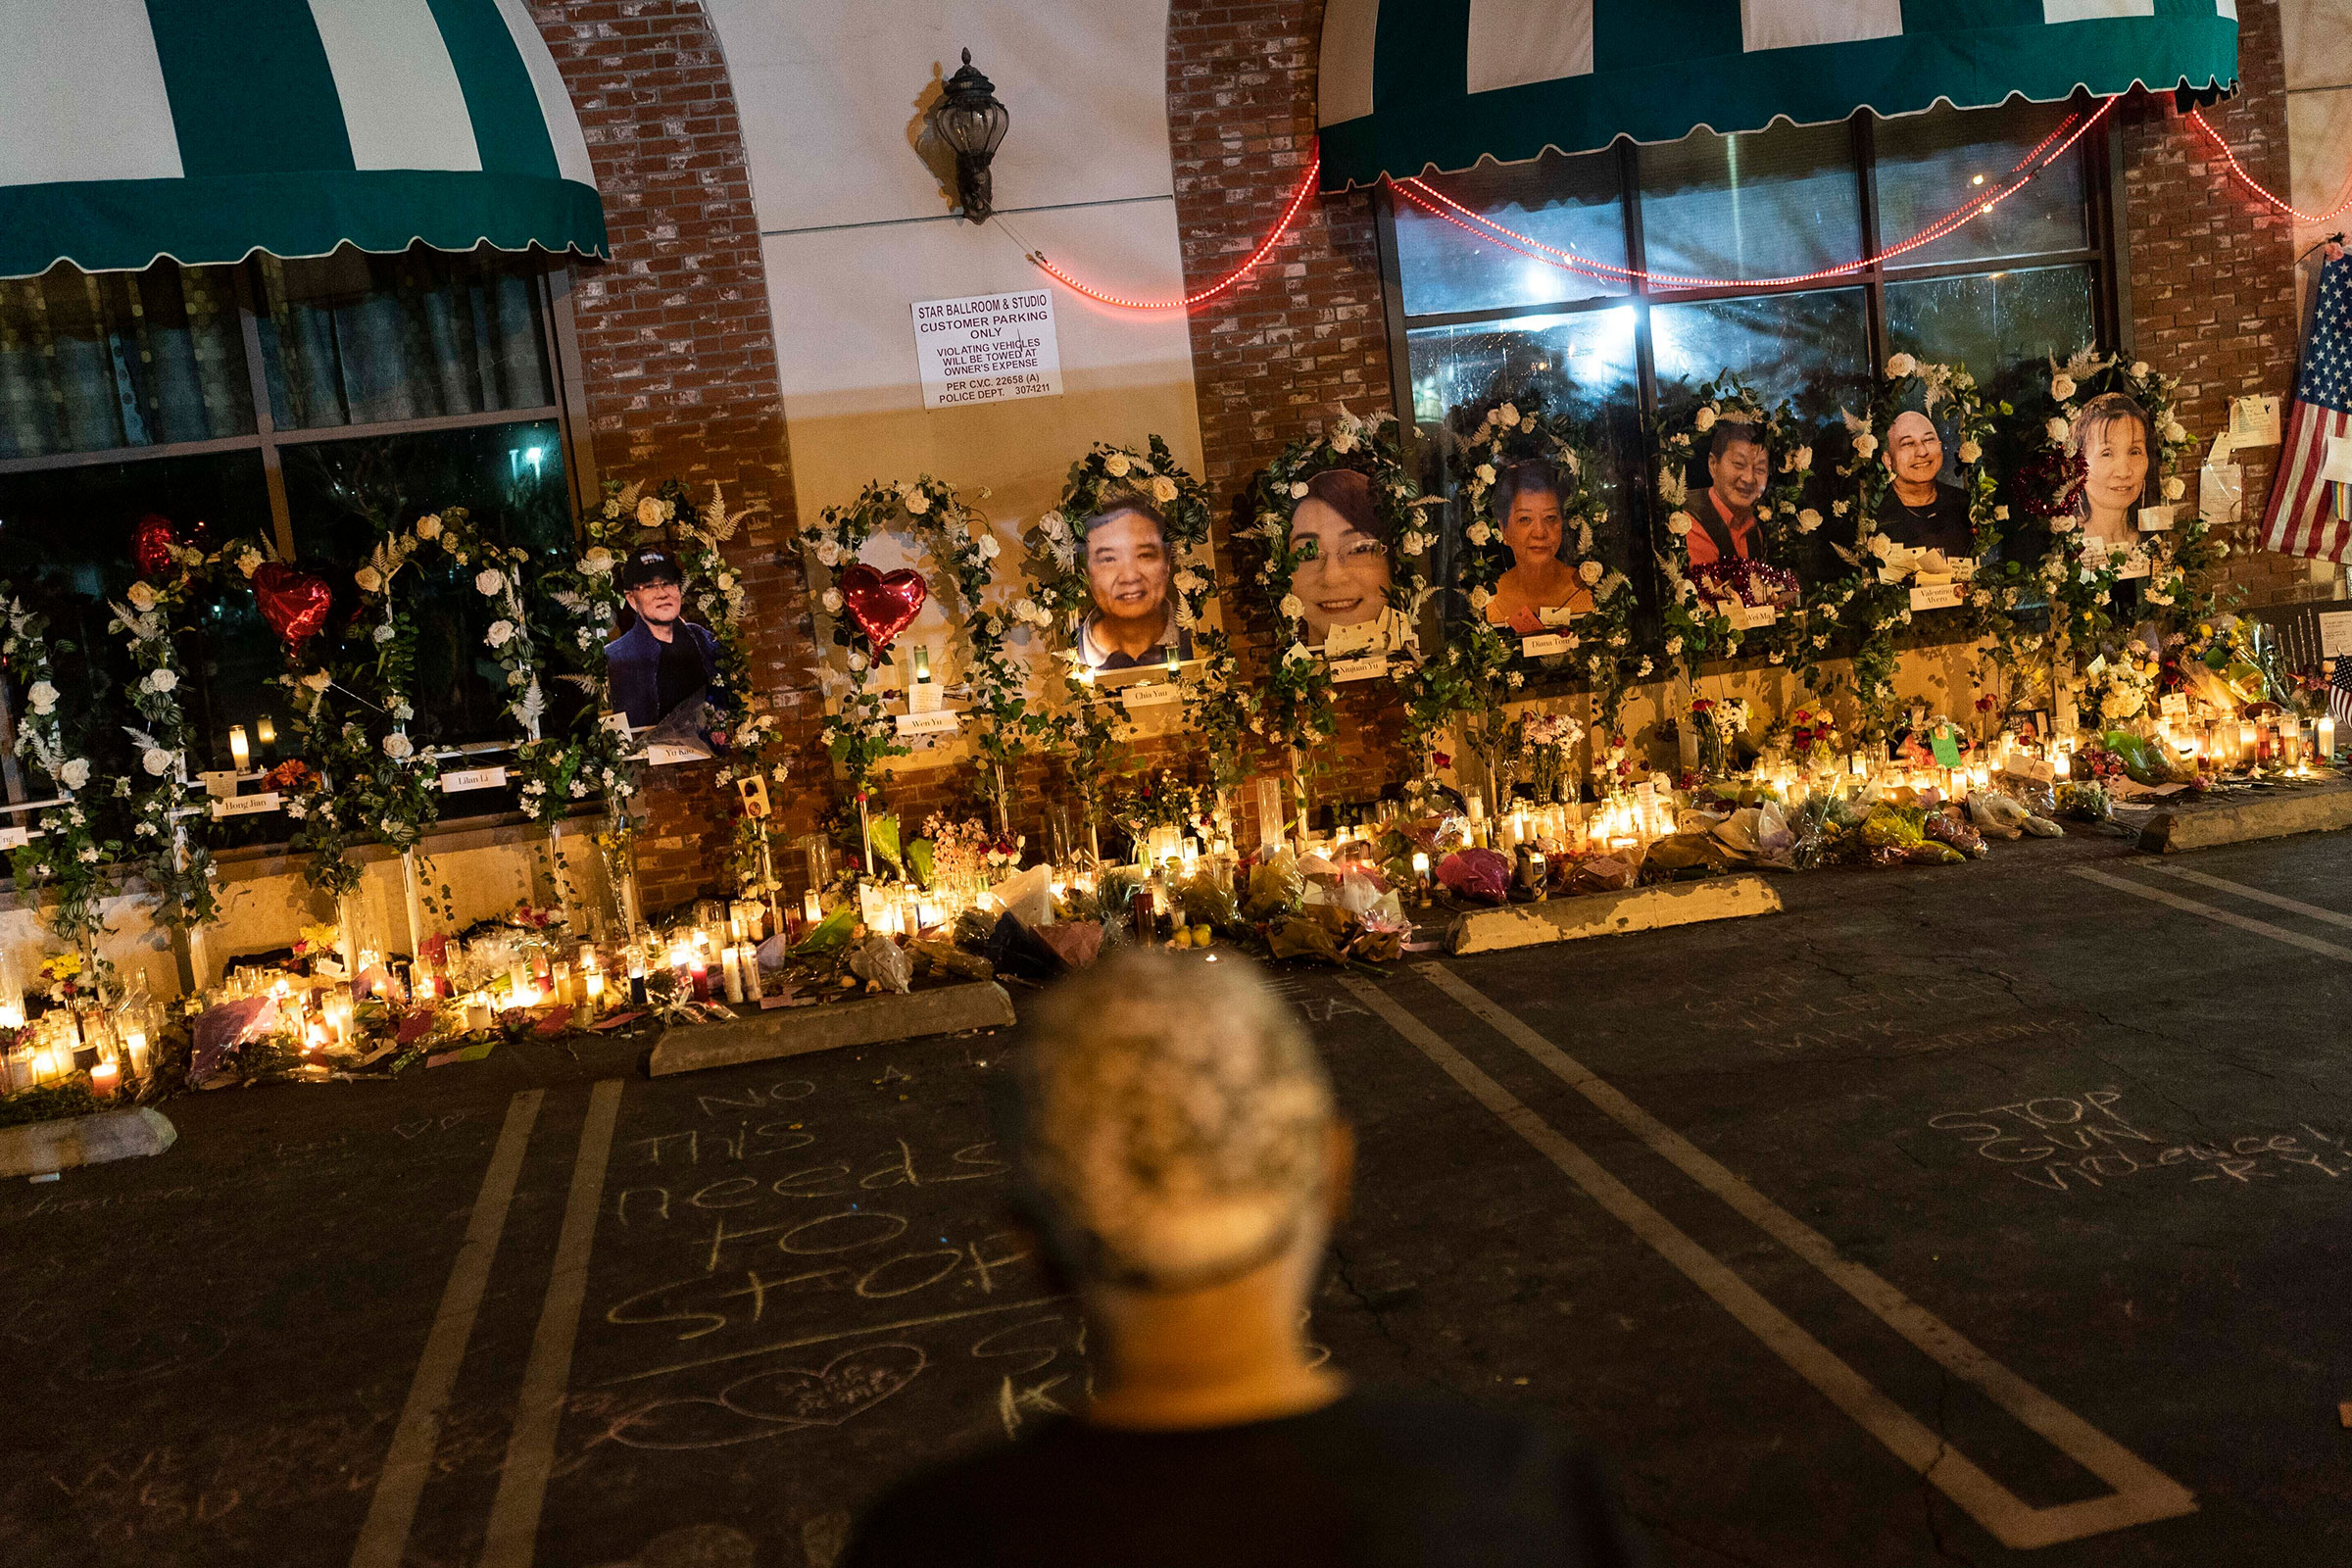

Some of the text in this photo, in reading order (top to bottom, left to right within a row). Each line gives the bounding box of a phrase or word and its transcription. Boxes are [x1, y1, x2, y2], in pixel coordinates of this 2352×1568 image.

[918, 294, 1047, 319] STAR BALLROOM & STUDIO
[920, 311, 1048, 333] CUSTOMER PARKING
[970, 327, 1002, 339] ONLY
[937, 338, 1041, 357] VIOLATING VEHICLES
[943, 348, 1037, 367] WILL BE TOWED AT
[944, 358, 1039, 376] OWNER'S EXPENSE
[947, 381, 967, 391] PER
[996, 374, 1024, 386] 22658
[1026, 373, 1040, 384] (A)
[939, 392, 975, 403] POLICE
[977, 388, 1005, 399] DEPT.
[1921, 588, 1952, 597] Valentino
[225, 799, 267, 810] Hong Jian
[1928, 1088, 2138, 1143] STOP
[1978, 1123, 2156, 1164] GUN
